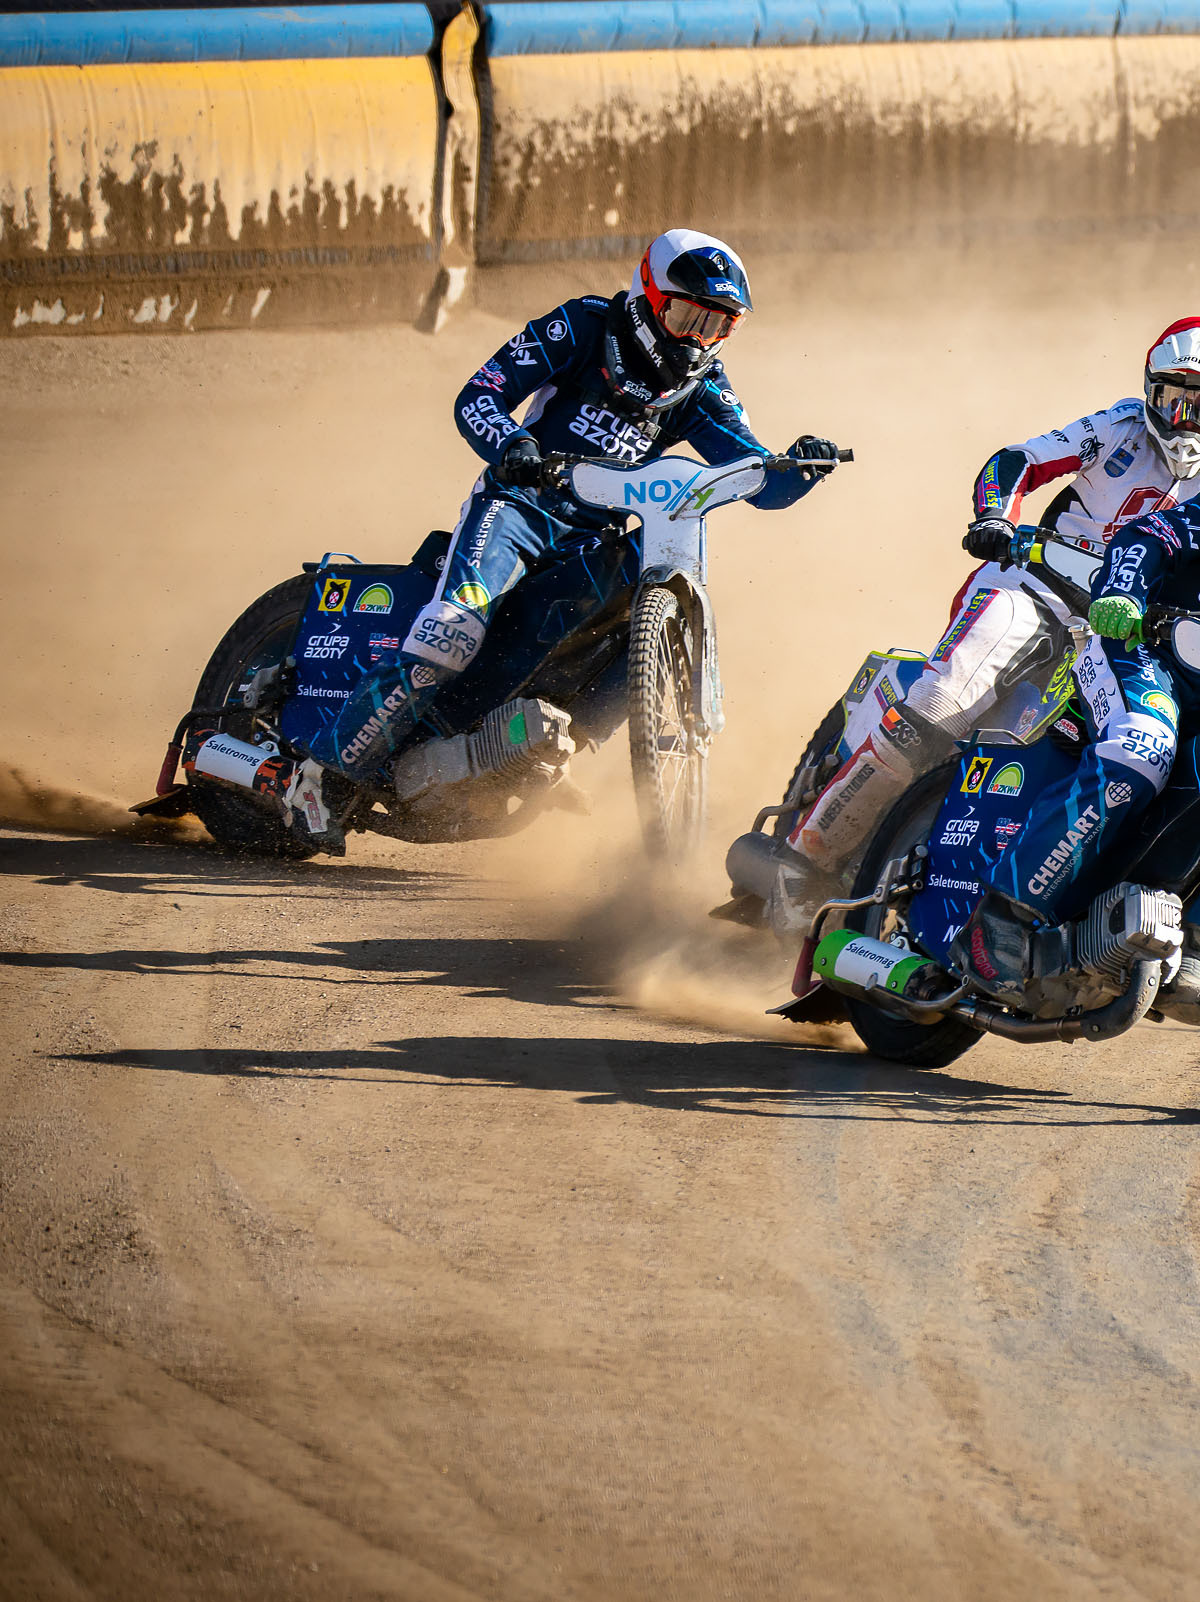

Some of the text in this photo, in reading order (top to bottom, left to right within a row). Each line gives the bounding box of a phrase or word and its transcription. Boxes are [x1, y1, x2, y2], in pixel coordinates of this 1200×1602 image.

[984, 483, 999, 491] 4
[985, 490, 999, 507] LESS
[468, 499, 505, 568] Saletromag
[935, 591, 987, 658] CARPETS 4 LESS
[341, 685, 408, 764] CHEMART
[205, 739, 260, 767] Saletromag
[1028, 804, 1101, 896] CHEMART
[928, 873, 979, 894] Saletromag
[846, 942, 895, 969] Saletromag
